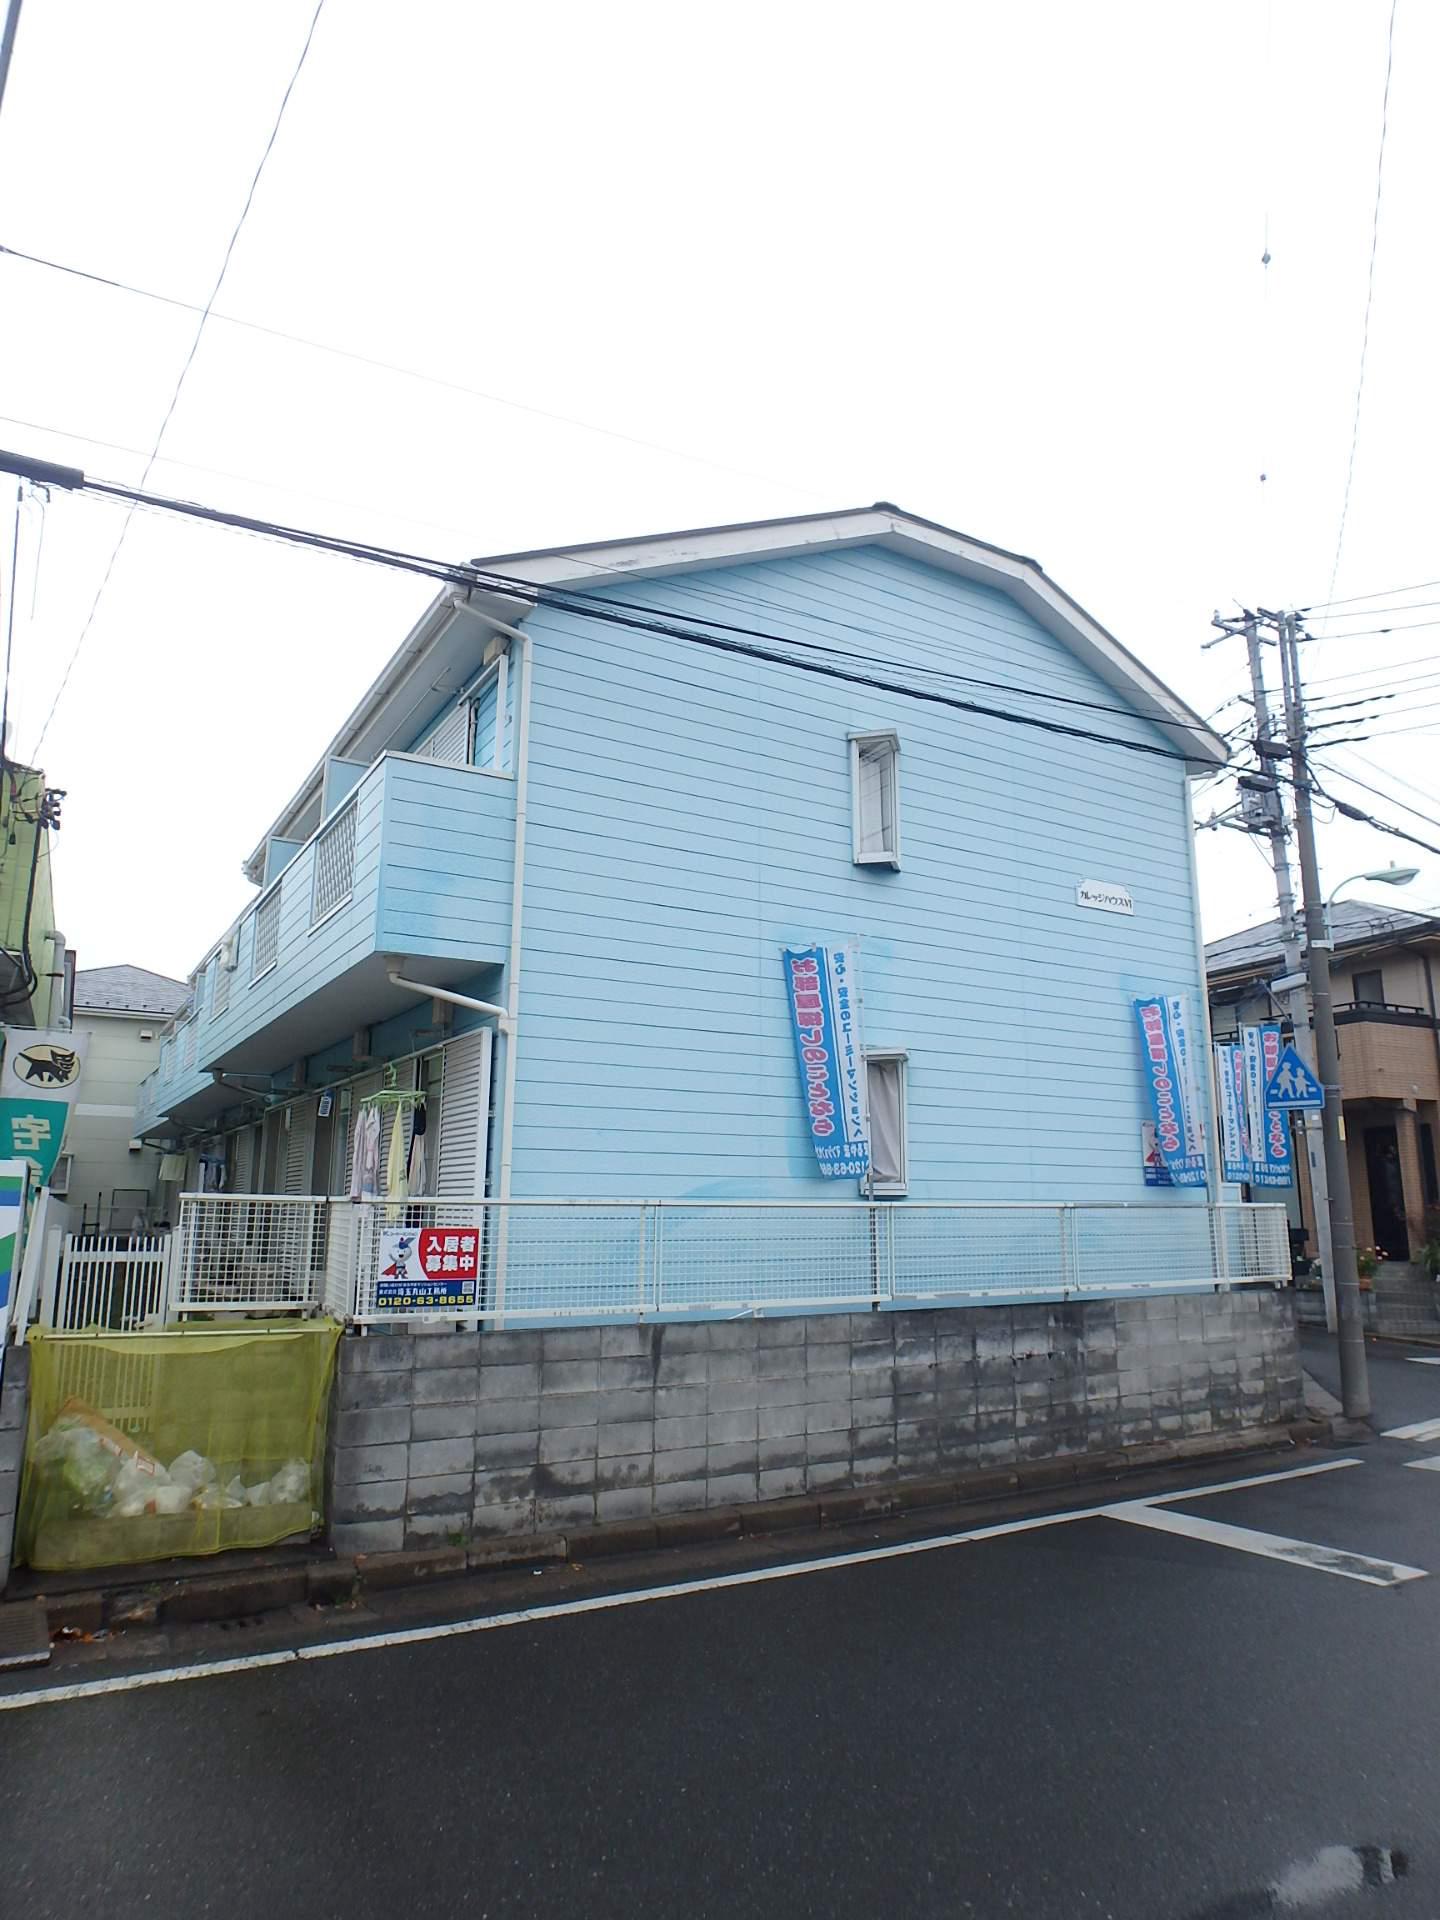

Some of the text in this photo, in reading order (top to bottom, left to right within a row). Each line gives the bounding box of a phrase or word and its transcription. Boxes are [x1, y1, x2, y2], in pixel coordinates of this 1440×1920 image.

[426, 1236, 475, 1253] 入居者
[425, 1254, 474, 1272] 募集中
